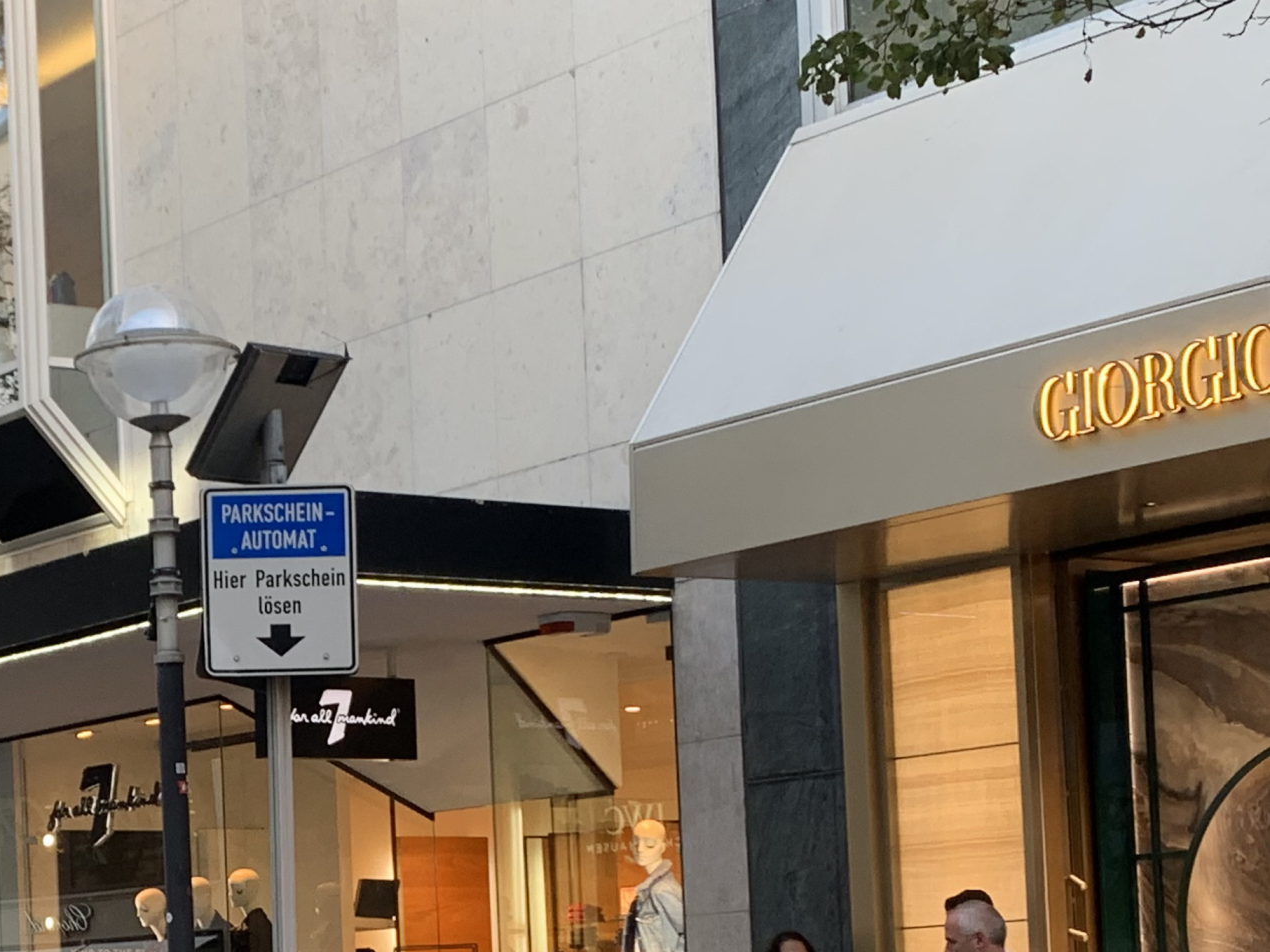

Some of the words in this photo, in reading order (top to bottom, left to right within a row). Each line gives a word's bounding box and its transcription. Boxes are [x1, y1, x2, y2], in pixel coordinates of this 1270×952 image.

[1033, 322, 1270, 442] GIORGIO
[221, 502, 335, 524] PARKSCHEIN-
[241, 529, 317, 550] AUTOMAT
[213, 570, 247, 589] Hier
[256, 567, 345, 588] Parkschein
[258, 595, 302, 615] lösen
[310, 708, 333, 724] all
[336, 708, 397, 727] mankind
